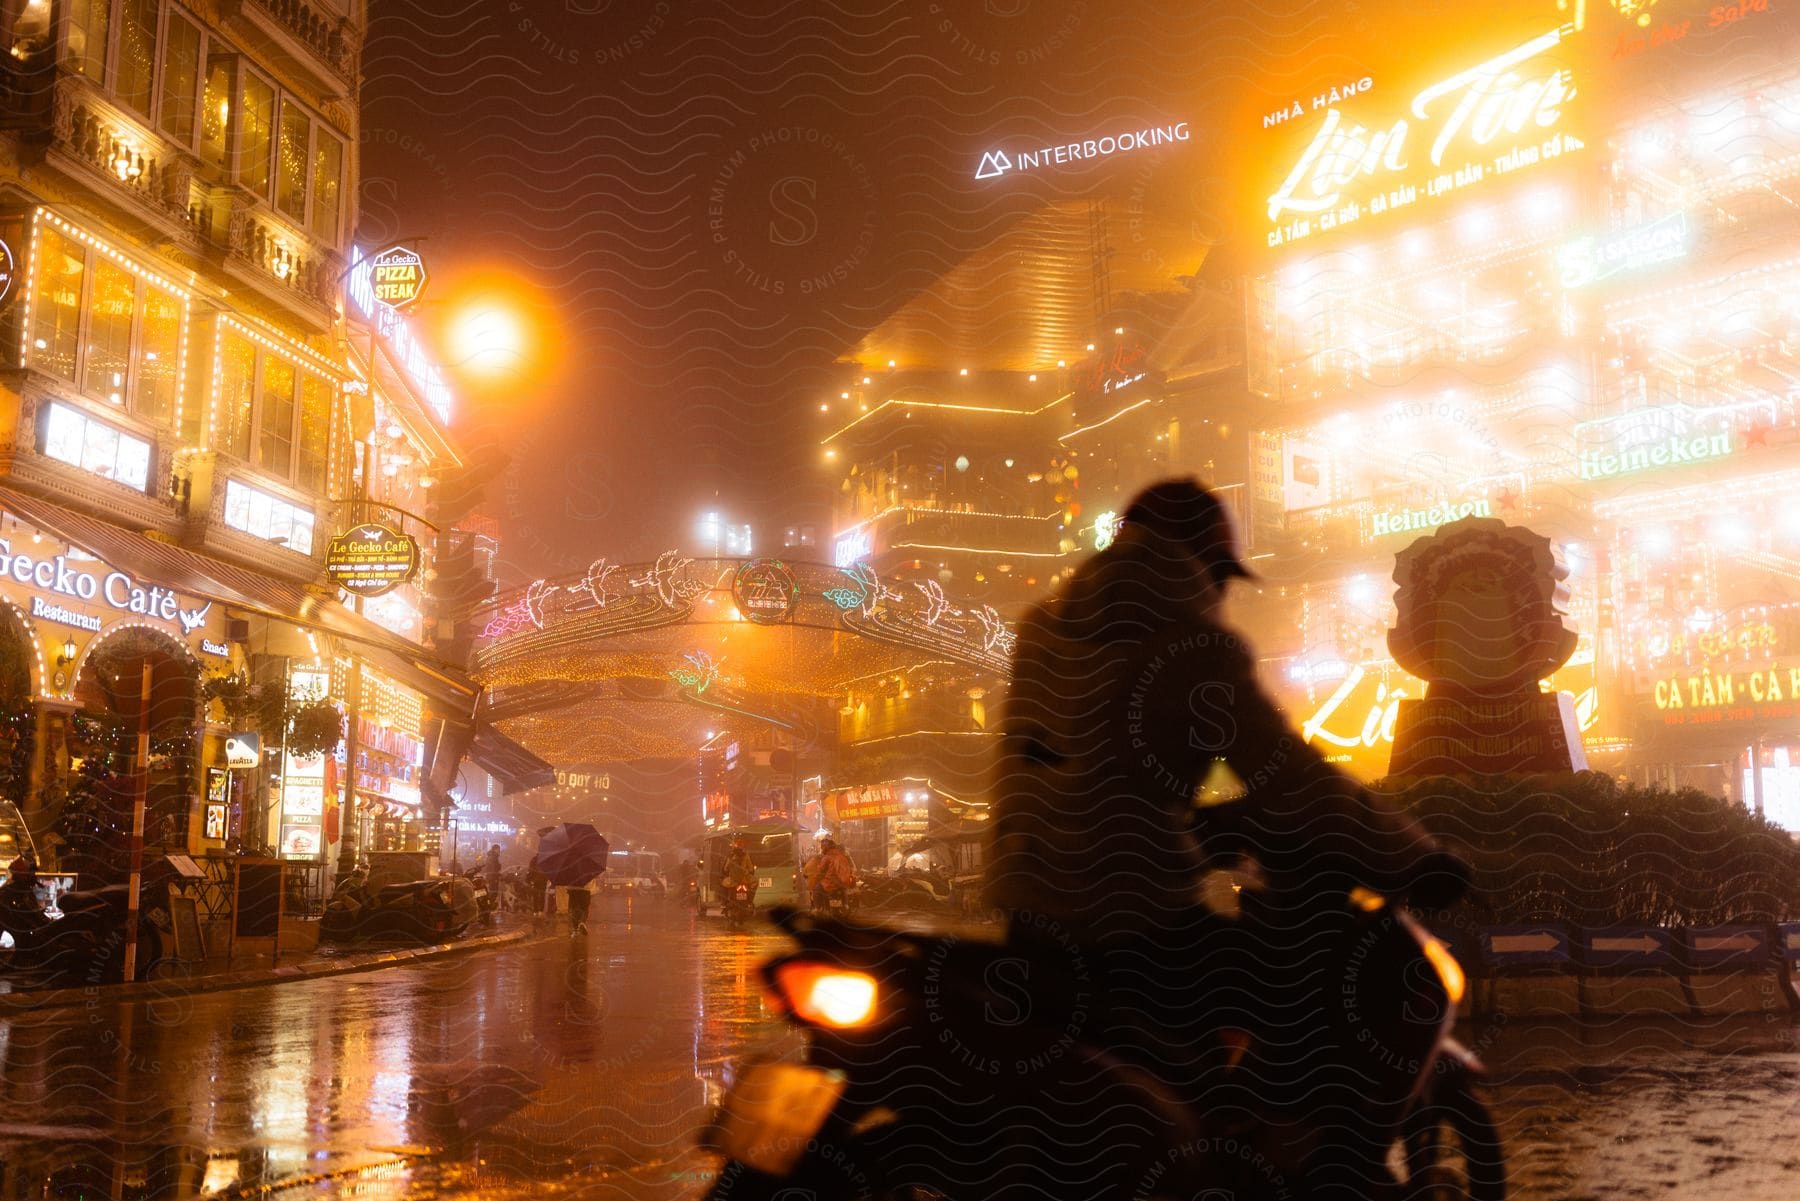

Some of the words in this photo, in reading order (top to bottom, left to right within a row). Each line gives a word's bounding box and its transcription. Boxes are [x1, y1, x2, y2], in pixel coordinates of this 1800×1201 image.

[1263, 101, 1304, 128] NHÀ
[1312, 77, 1374, 109] HÀNG
[1018, 122, 1190, 172] INTERBOOKING
[1268, 230, 1283, 247] CÁ
[1321, 213, 1337, 233] CÁ
[376, 265, 416, 282] PIZZA
[380, 255, 391, 264] Le
[391, 254, 416, 264] Gecko
[375, 283, 415, 299] STEAK
[1580, 431, 1732, 480] Heineken
[1372, 499, 1491, 538] Heineken
[333, 542, 346, 553] Le
[349, 541, 382, 553] Gecko
[385, 540, 408, 552] Café
[104, 572, 177, 620] Café
[32, 597, 102, 631] Restaurant
[203, 639, 229, 657] Snack
[1655, 672, 1683, 709] CÁ
[1750, 661, 1783, 701] CÁ
[1302, 665, 1400, 747] Liê
[287, 777, 323, 786] SPAGHETTI
[292, 815, 312, 824] PIZZA
[286, 853, 314, 861] BURGER
